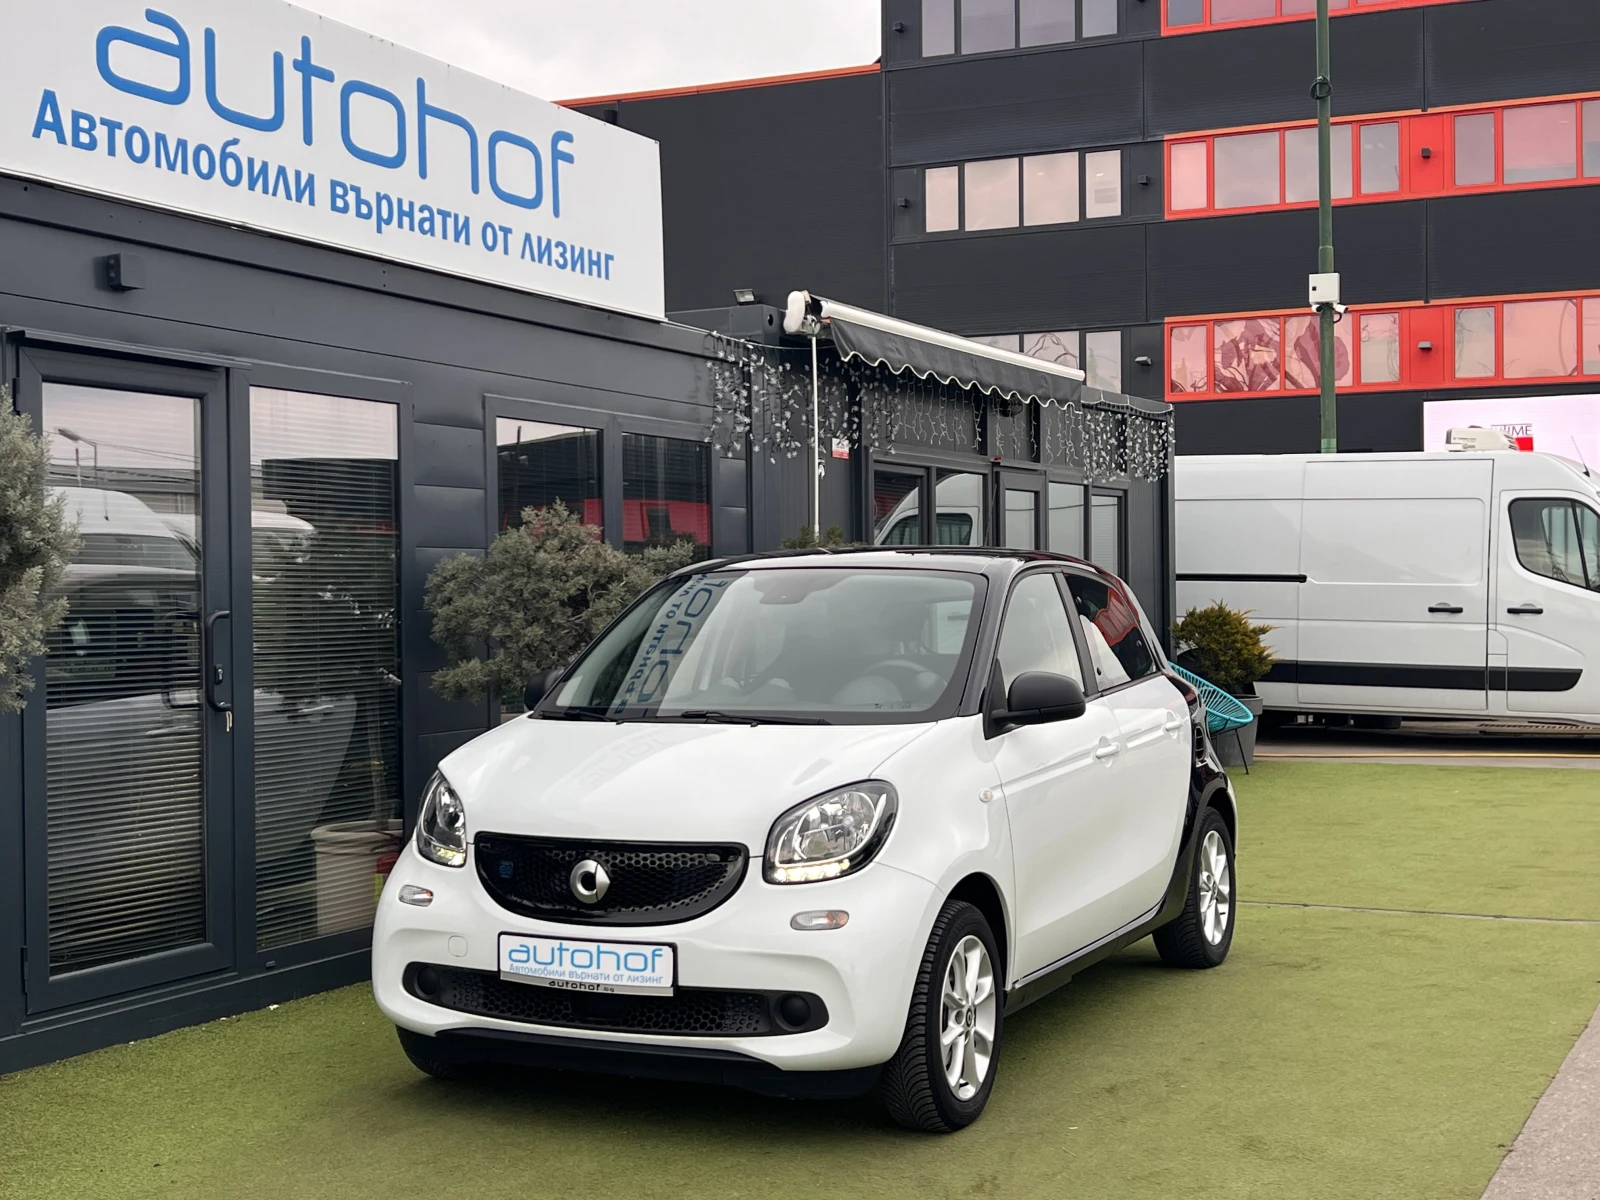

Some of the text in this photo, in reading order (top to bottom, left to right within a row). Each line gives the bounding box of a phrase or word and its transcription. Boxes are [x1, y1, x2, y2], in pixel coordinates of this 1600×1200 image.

[96, 9, 575, 218] autohof
[32, 89, 614, 280] Автомобили върнати от лизинг
[508, 941, 663, 974] autohof
[509, 963, 663, 984] Автомобили върнати от лизинг
